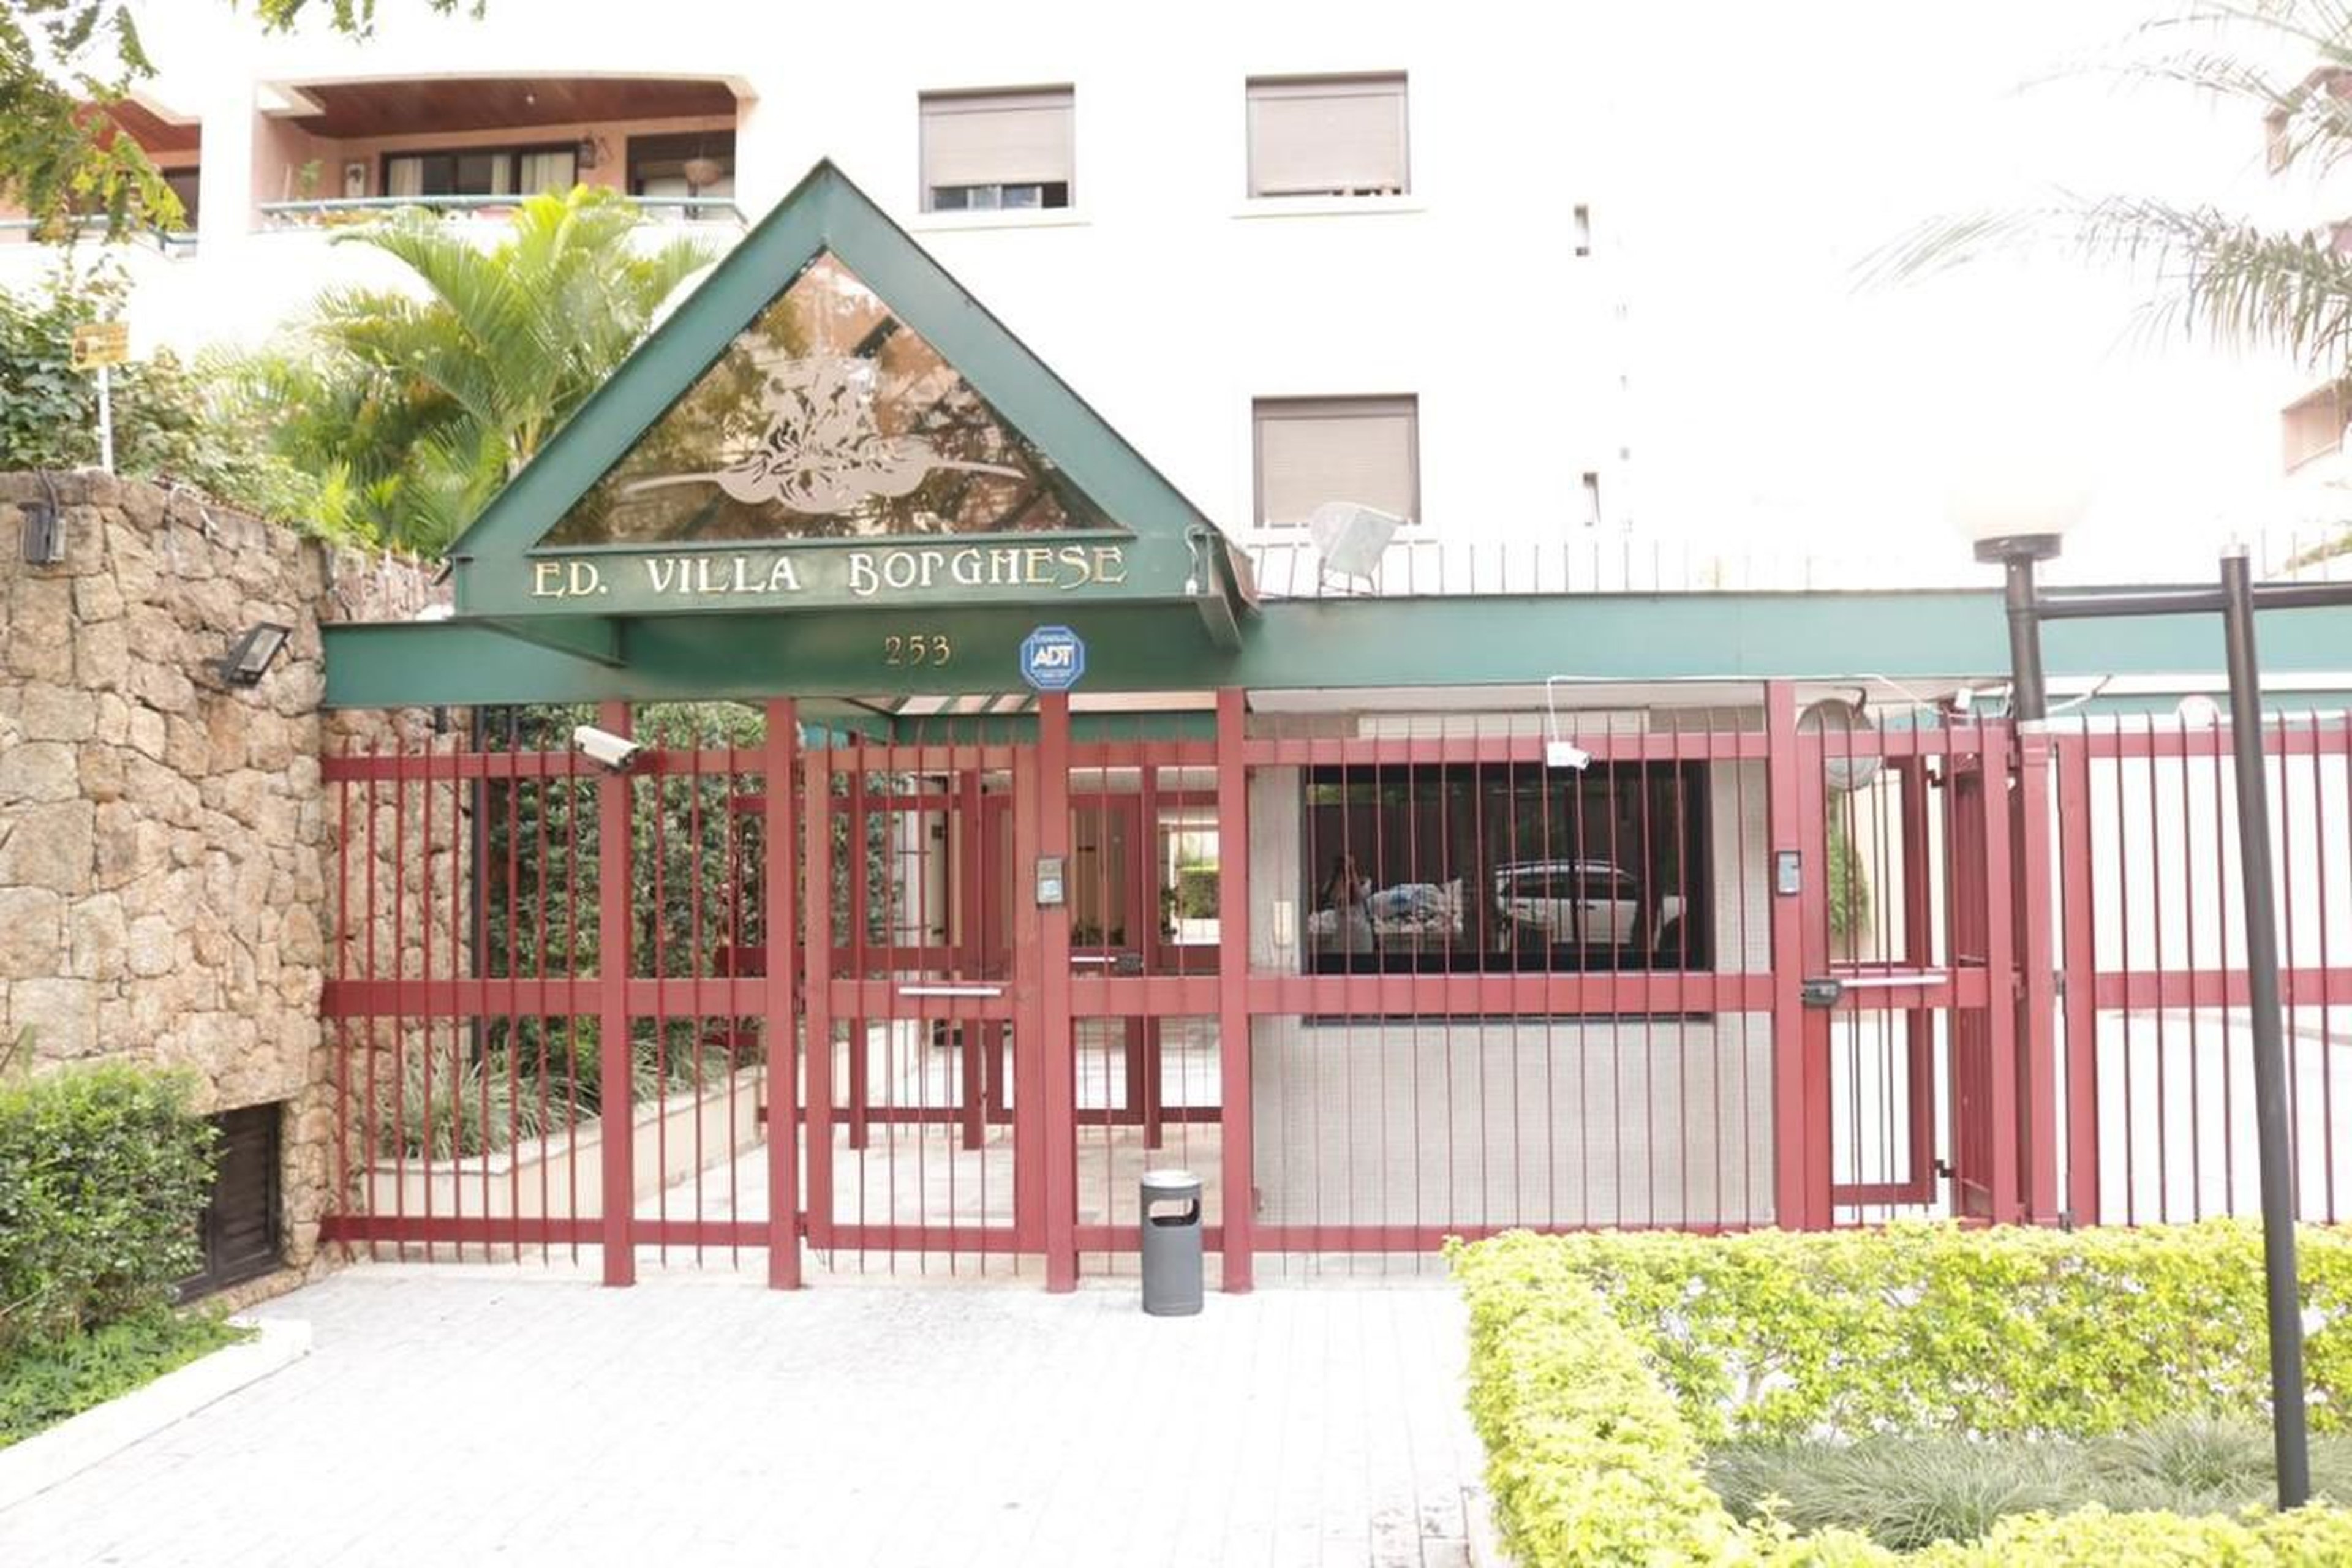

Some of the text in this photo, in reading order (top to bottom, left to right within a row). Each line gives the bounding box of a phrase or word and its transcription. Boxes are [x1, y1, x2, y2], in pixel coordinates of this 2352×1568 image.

[532, 560, 608, 598] ED.
[645, 556, 801, 594] VILLA
[884, 635, 951, 665] 253
[1031, 644, 1074, 666] ADT
